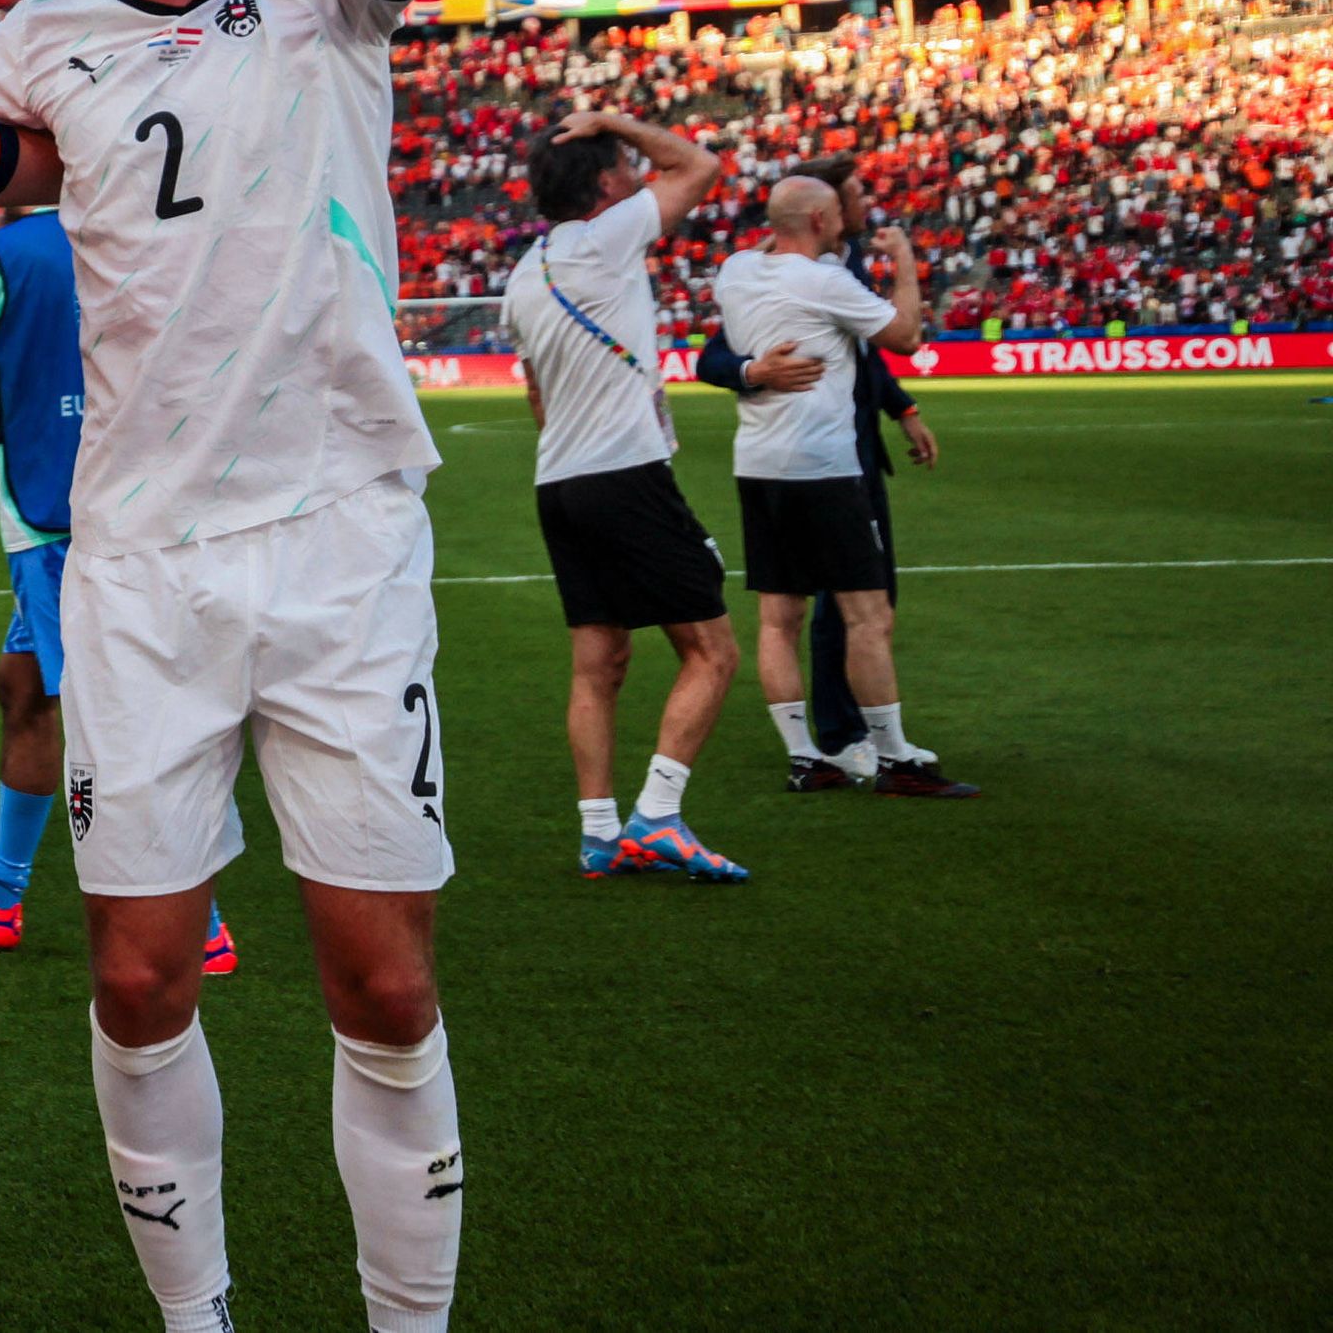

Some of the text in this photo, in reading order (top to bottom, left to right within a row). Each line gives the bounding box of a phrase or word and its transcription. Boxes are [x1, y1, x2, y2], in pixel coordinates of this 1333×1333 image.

[135, 110, 205, 220] 2
[990, 336, 1274, 374] STRAUSS.COM
[403, 682, 438, 798] 2
